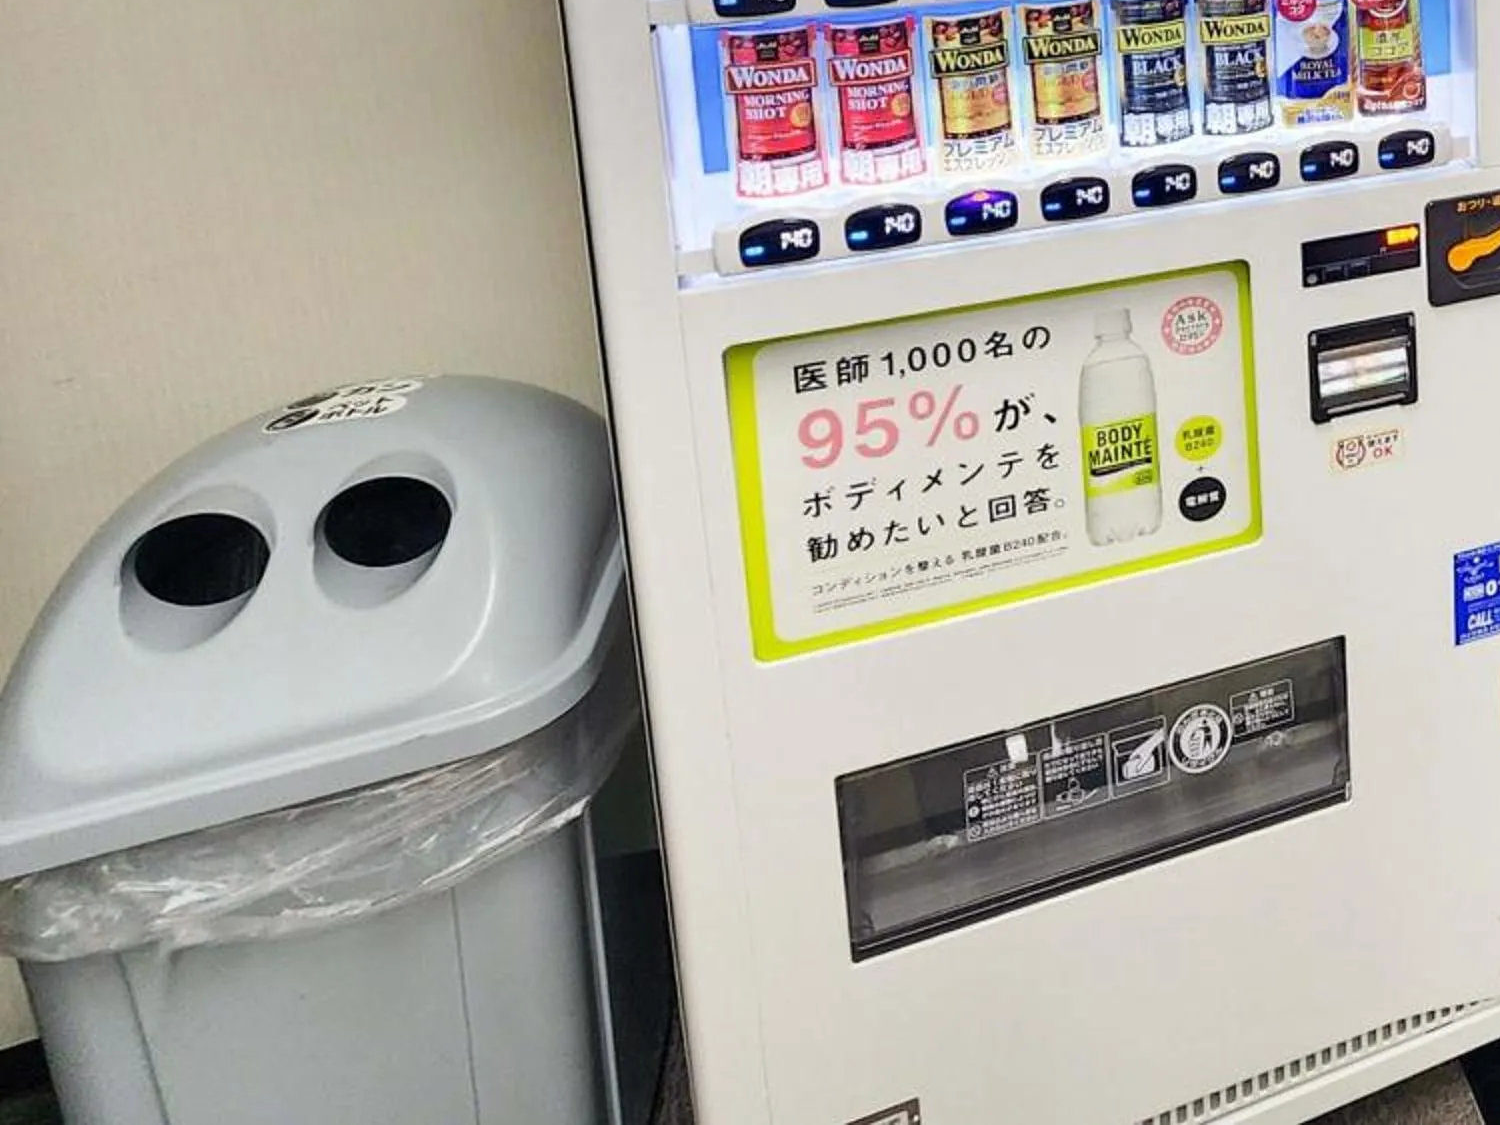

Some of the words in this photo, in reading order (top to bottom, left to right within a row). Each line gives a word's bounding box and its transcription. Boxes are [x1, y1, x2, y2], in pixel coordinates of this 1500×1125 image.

[1121, 27, 1181, 47] WONDA
[1206, 19, 1265, 39] WONDA
[1029, 36, 1096, 58] WONDA
[1215, 47, 1263, 66] BLACK
[833, 57, 907, 81] WONDA
[935, 48, 1003, 72] WONDA
[1132, 55, 1181, 74] BLACK
[729, 66, 810, 89] WONDA
[743, 88, 810, 107] MORNING
[847, 80, 909, 98] MORNING
[745, 106, 787, 120] SHOT
[849, 96, 888, 111] SHOT
[1034, 119, 1103, 142] プレミアム
[944, 132, 1015, 158] プレミアム
[1176, 311, 1206, 327] Ask
[793, 324, 1051, 394] 医師1,000名の
[1097, 422, 1142, 445] BODY
[1373, 444, 1393, 459] OK
[802, 441, 1060, 519] ボディメンテを
[807, 487, 1067, 562] 勧めたいと回答。
[813, 554, 955, 596] コンディションを整える
[961, 529, 1068, 561] 乳酸菌B240配合。
